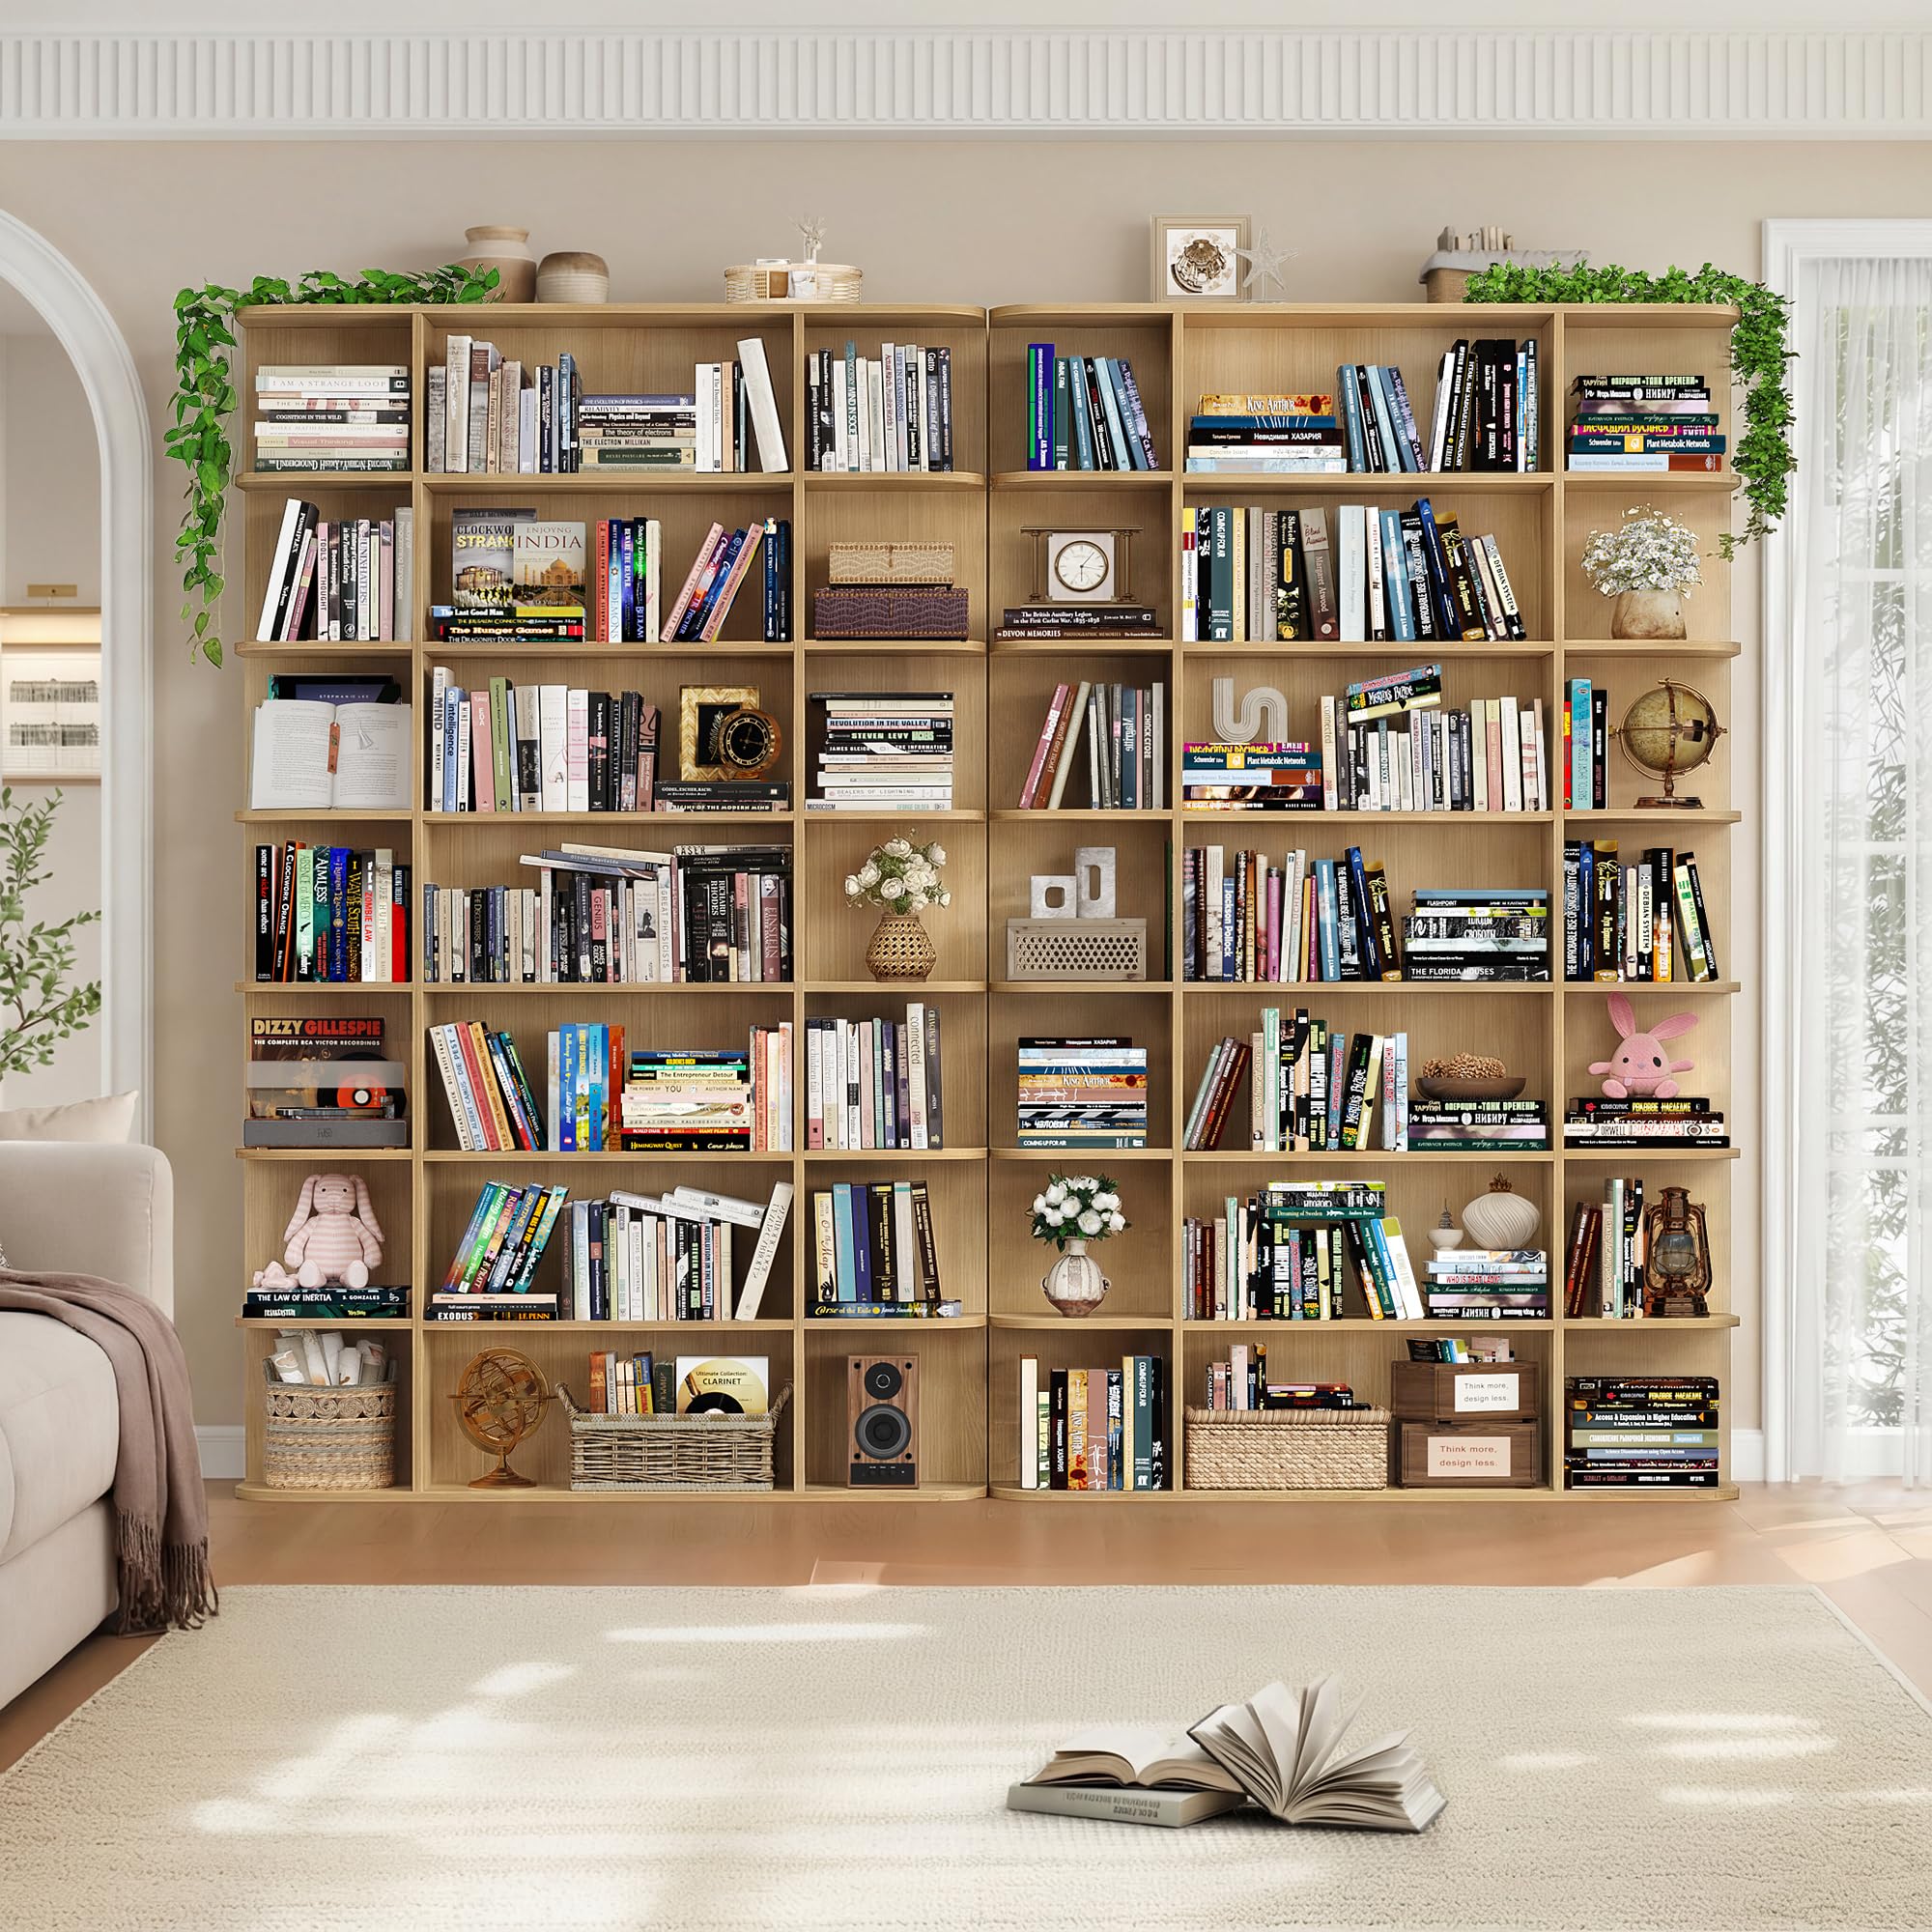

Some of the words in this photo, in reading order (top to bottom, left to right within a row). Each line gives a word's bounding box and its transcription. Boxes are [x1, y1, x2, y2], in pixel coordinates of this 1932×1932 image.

[927, 353, 936, 371] Gatto
[1647, 440, 1660, 448] Plant
[1661, 440, 1685, 448] Metabolic
[1686, 440, 1710, 448] Networks
[457, 526, 514, 534] CLOCKWO
[517, 535, 582, 549] INDIA
[1314, 555, 1324, 585] Margaret
[1319, 587, 1329, 612] Atwood
[1492, 559, 1505, 584] DEBIAN
[1501, 585, 1516, 611] SYSTEM
[611, 591, 619, 639] DEMONS
[434, 697, 443, 730] MIND
[1247, 756, 1260, 765] Plant
[1261, 756, 1284, 765] Metabolic
[282, 855, 294, 901] CLOCKWORK
[314, 858, 328, 902] AIMLESS
[347, 872, 361, 896] WAY
[710, 880, 719, 916] RHODES
[1225, 889, 1234, 923] Jackson
[279, 903, 289, 934] ORANGE
[347, 907, 359, 934] SOUTH
[594, 896, 603, 930] GENIUS
[769, 907, 778, 958] EINSTEIN
[1688, 901, 1696, 924] HARRY
[1693, 927, 1703, 954] POTTER
[1224, 925, 1234, 957] Pollock
[254, 1020, 303, 1035] DIZZY
[304, 1020, 381, 1036] GILLESPIE
[810, 1031, 819, 1045] how
[450, 1038, 460, 1060] PEST
[810, 1047, 821, 1079] children
[824, 1050, 835, 1081] children
[461, 1081, 470, 1104] CAMUS
[810, 1081, 821, 1093] fail
[825, 1083, 835, 1102] learn
[467, 1106, 477, 1129] ALBERT
[1311, 1100, 1325, 1115] ПЕС
[1475, 1114, 1508, 1124] НИБИРУ
[1601, 1125, 1626, 1136] ORWELL
[814, 1306, 838, 1315] Curse
